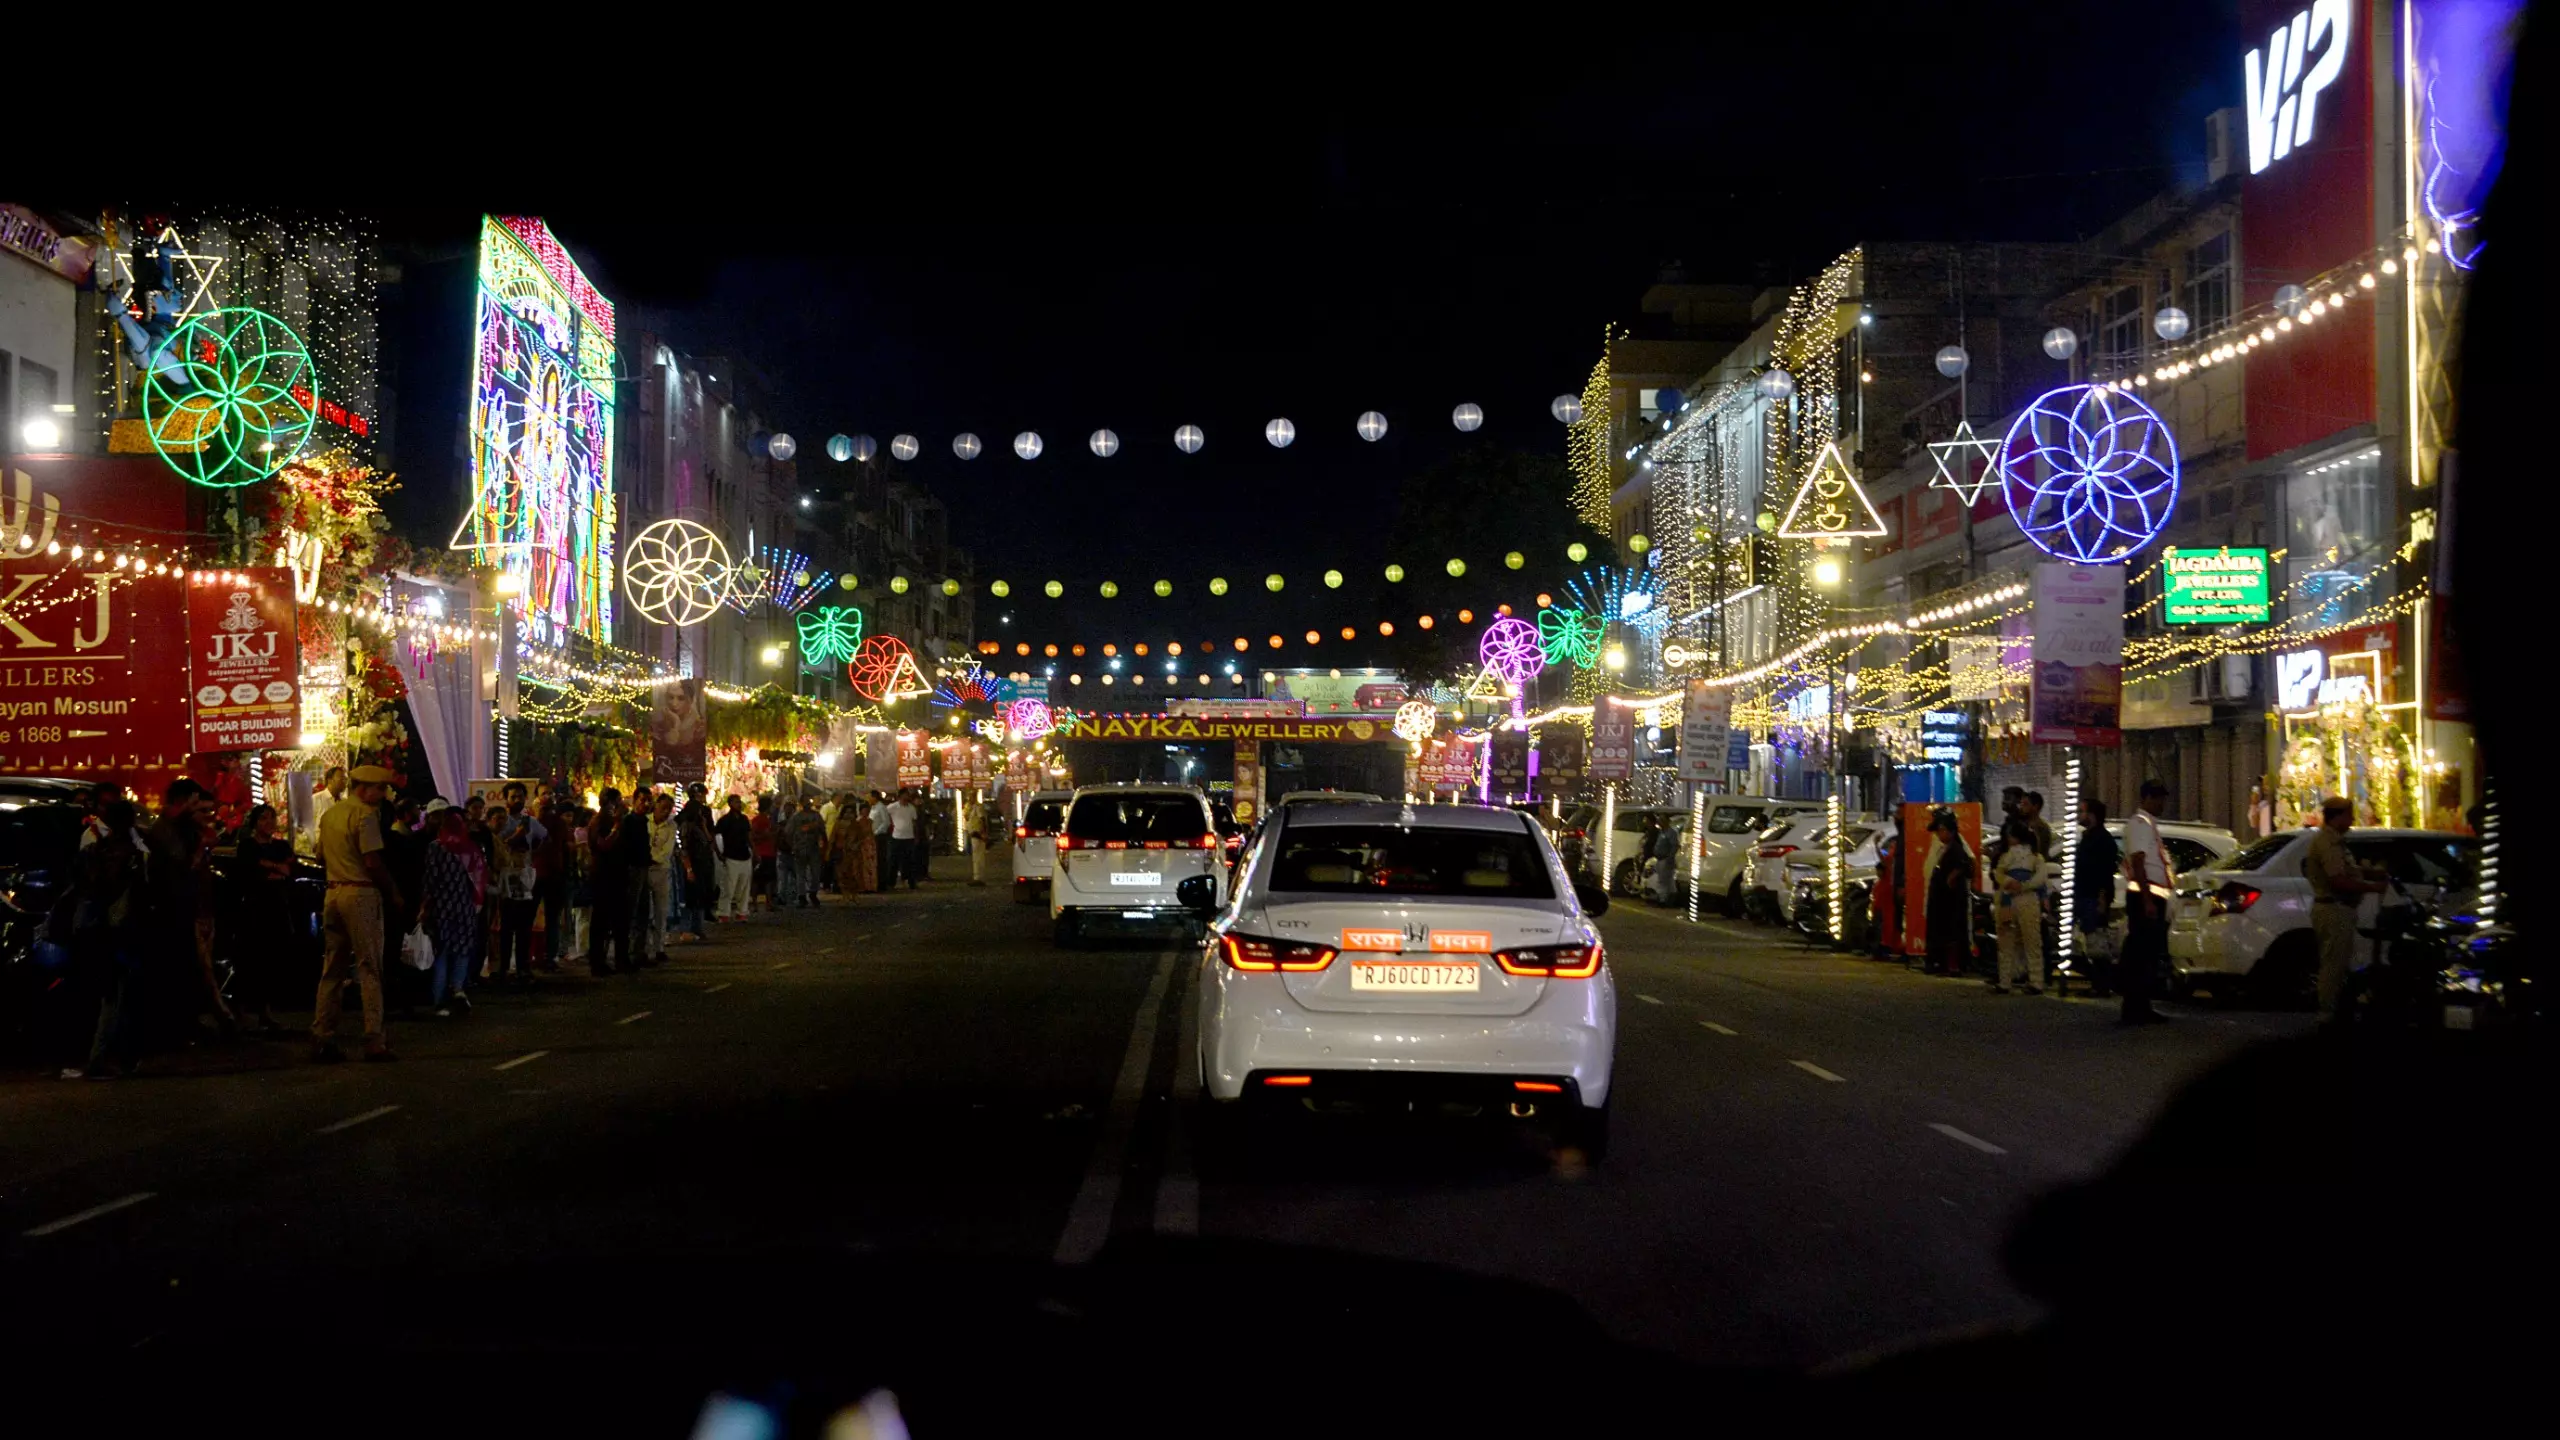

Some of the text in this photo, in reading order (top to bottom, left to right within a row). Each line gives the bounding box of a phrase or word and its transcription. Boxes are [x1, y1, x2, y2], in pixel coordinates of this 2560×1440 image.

[2245, 0, 2351, 175] VIP
[2168, 555, 2264, 572] JAGDAMBA
[2174, 574, 2259, 588] JEWELLERS
[206, 631, 280, 660] JKJ
[218, 658, 270, 669] JEWELLERS
[0, 666, 96, 687] LLERS
[54, 696, 128, 716] Mosun
[200, 717, 293, 733] DUGAR BUILDING
[1052, 718, 1201, 739] NAYKA
[1202, 723, 1345, 739] JEWELLERY
[1597, 724, 1626, 738] JKJ
[18, 725, 62, 743] 1868
[242, 731, 275, 744] ROAD
[902, 749, 925, 760] JKJ
[946, 755, 967, 765] JKJ
[1424, 751, 1443, 761] JKJ
[1449, 750, 1471, 760] JKJ
[1277, 919, 1311, 928] CITY
[1346, 931, 1489, 949] राज भवन
[1365, 966, 1476, 985] RJ60CD1723
